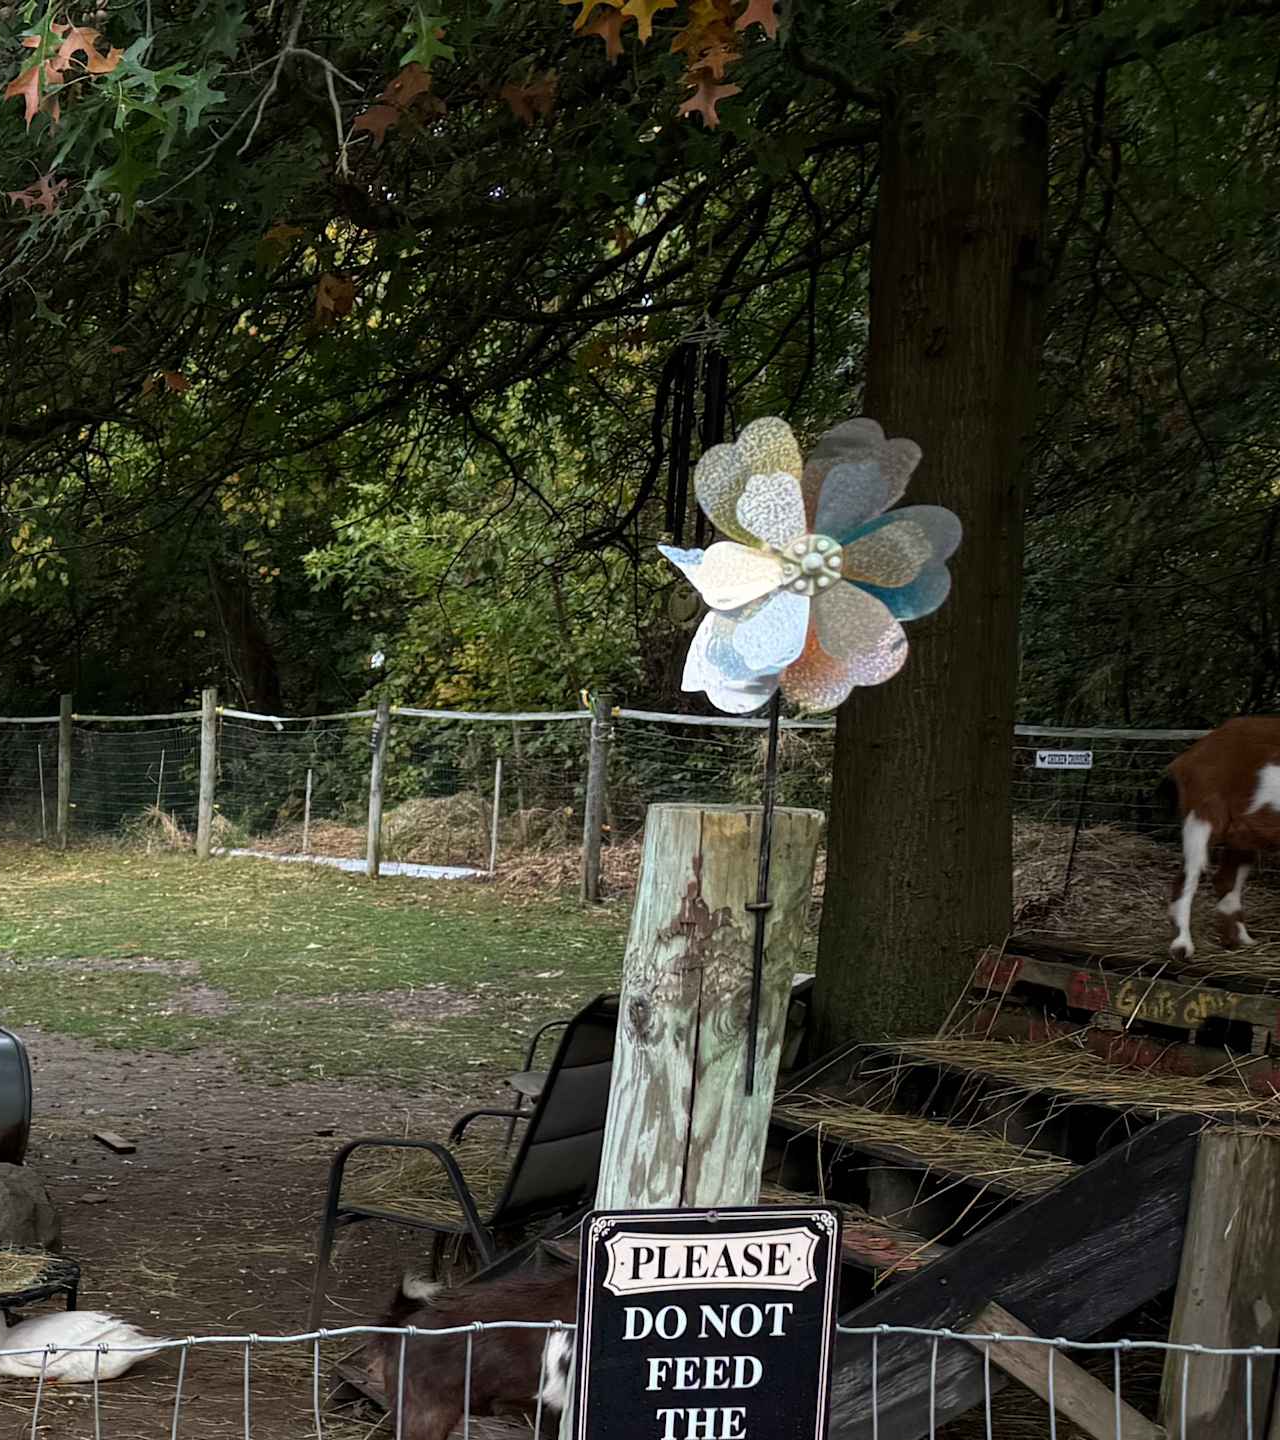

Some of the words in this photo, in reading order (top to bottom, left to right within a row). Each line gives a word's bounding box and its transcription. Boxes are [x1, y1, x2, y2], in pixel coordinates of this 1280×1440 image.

[628, 1241, 792, 1280] PLEASE
[622, 1304, 688, 1341] DO
[697, 1302, 794, 1340] NOT
[644, 1354, 764, 1392] FEED
